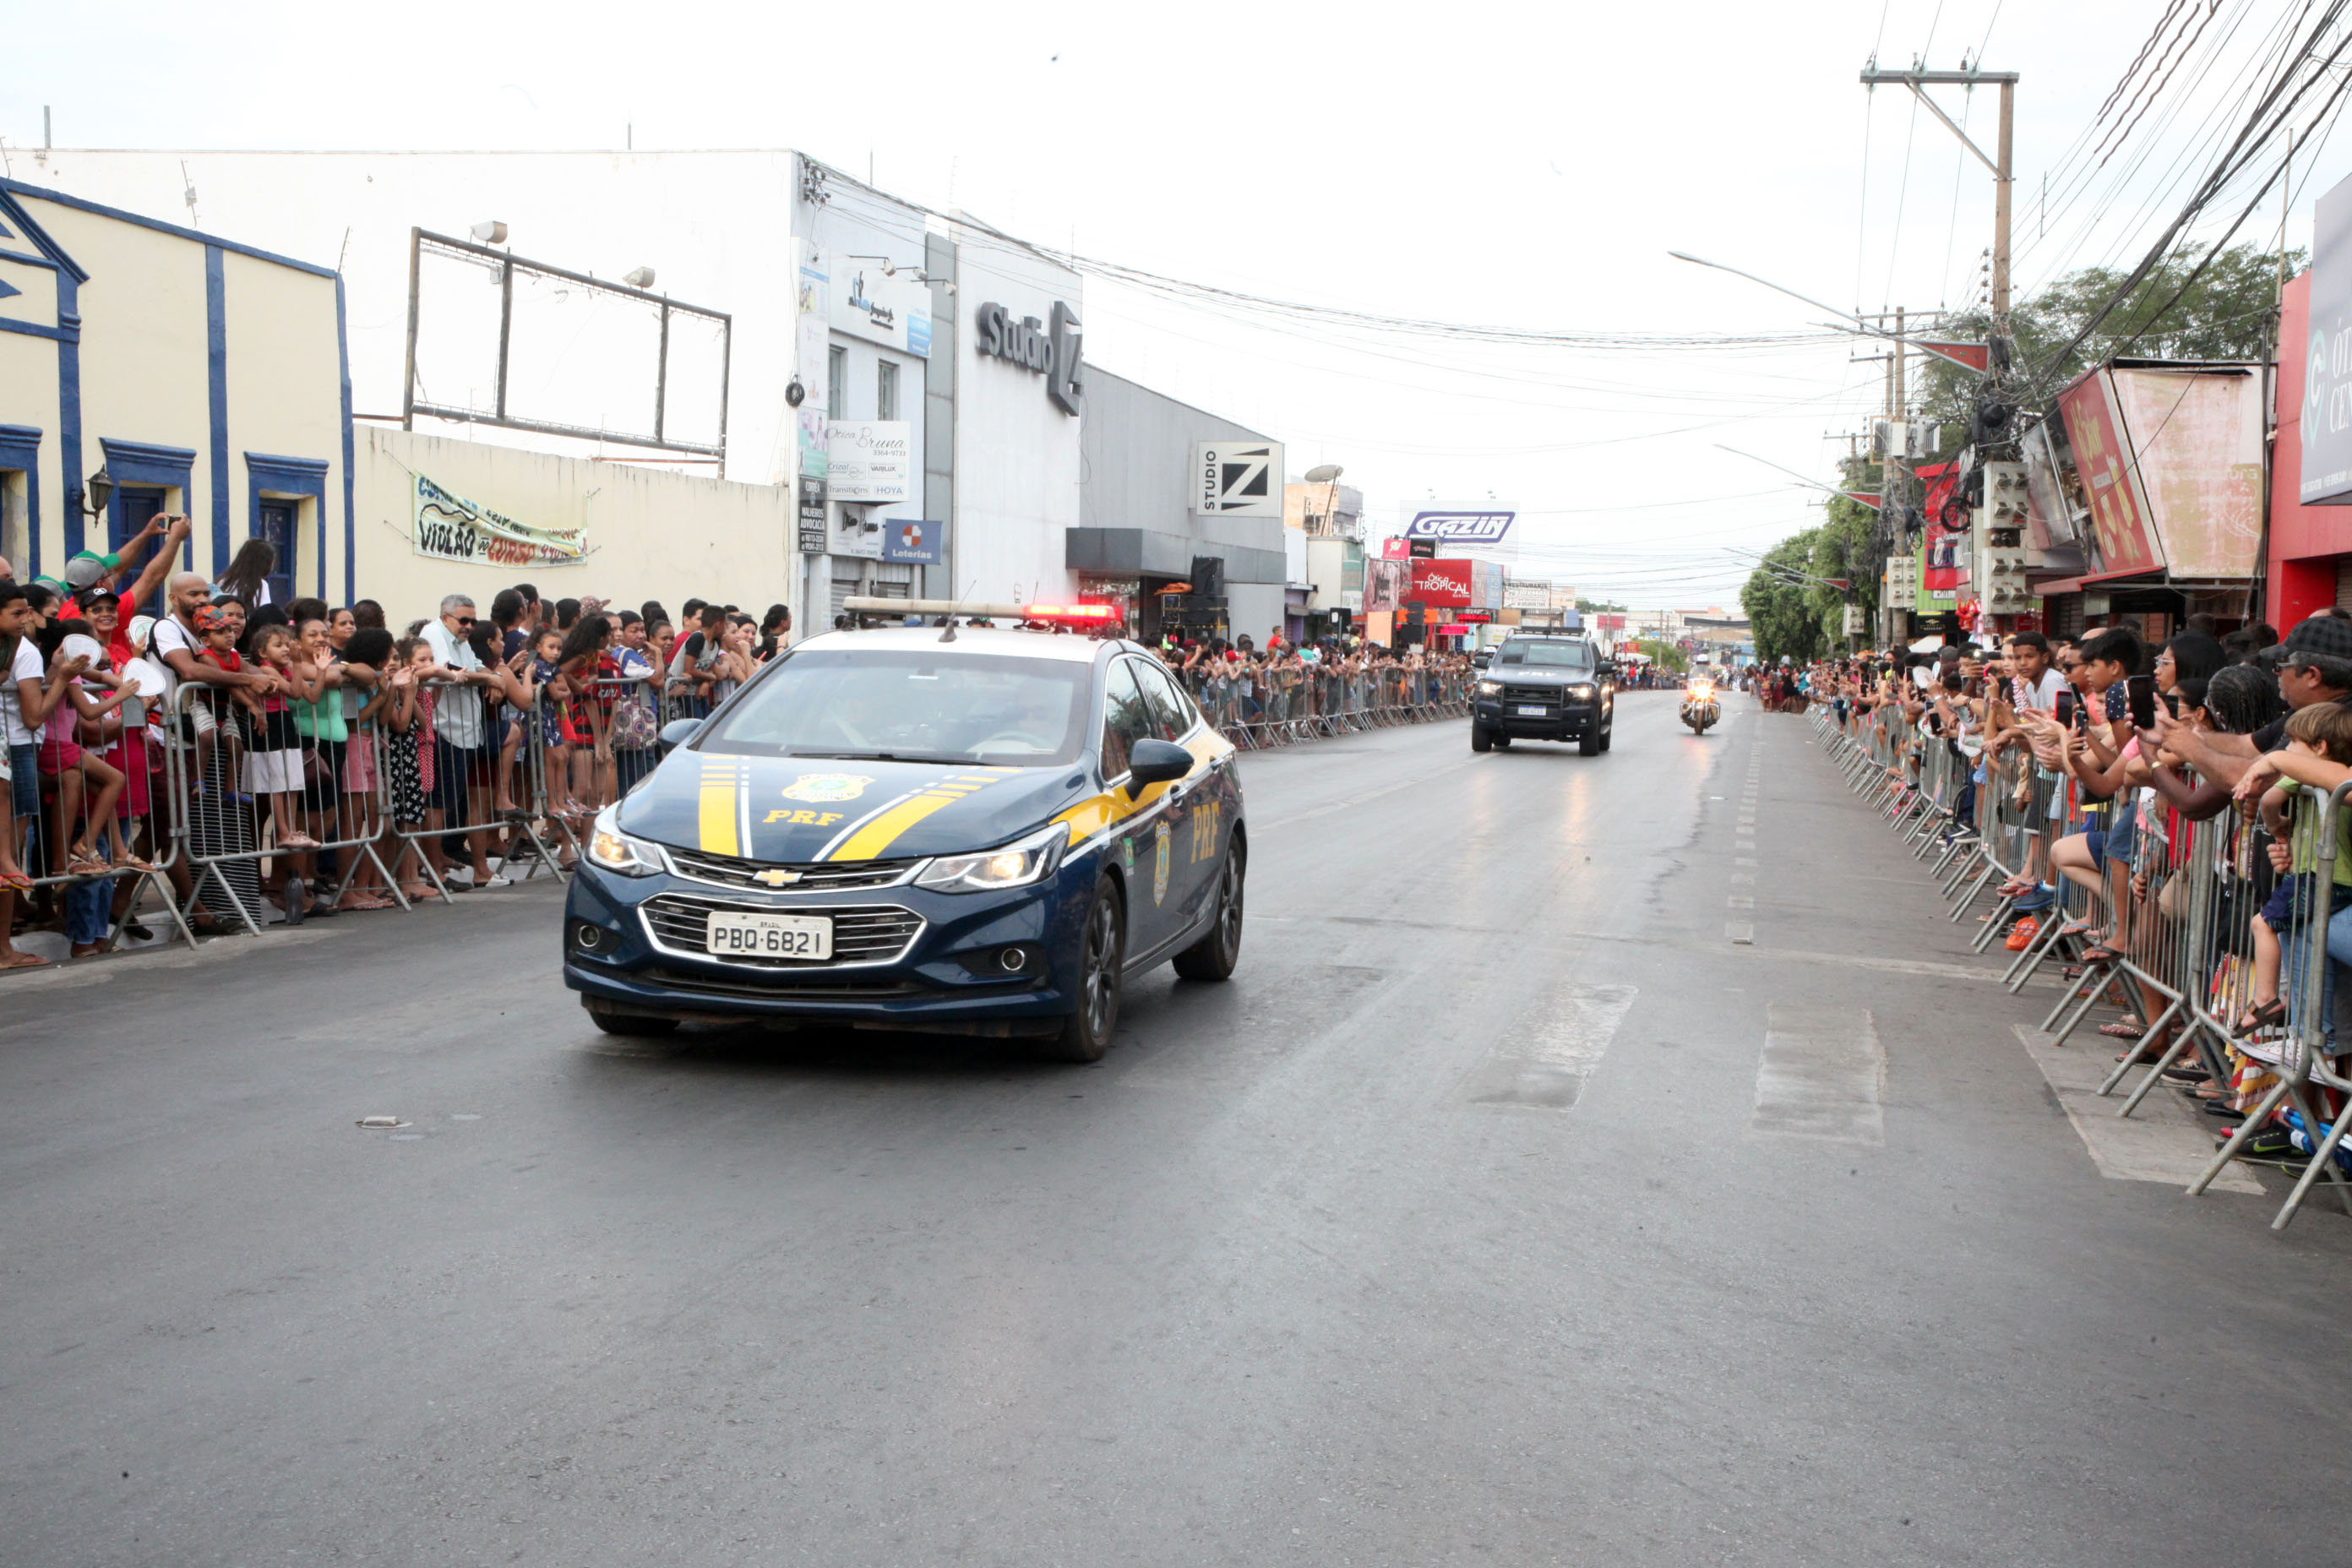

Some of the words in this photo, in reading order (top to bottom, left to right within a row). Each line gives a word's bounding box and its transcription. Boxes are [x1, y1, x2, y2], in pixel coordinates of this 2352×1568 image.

[980, 302, 1054, 373] Studio
[856, 427, 905, 448] Bruna
[1205, 450, 1217, 510] STUDIO
[829, 485, 869, 495] Transitions
[876, 487, 903, 495] HOYA
[800, 518, 825, 531] ADVOCACIA
[422, 521, 476, 558] VIOLÃO
[487, 536, 537, 566] CURSO
[892, 549, 933, 559] Loterias
[1414, 580, 1470, 595] TROPICAL
[762, 809, 845, 826] PRF
[1190, 801, 1220, 864] PRF
